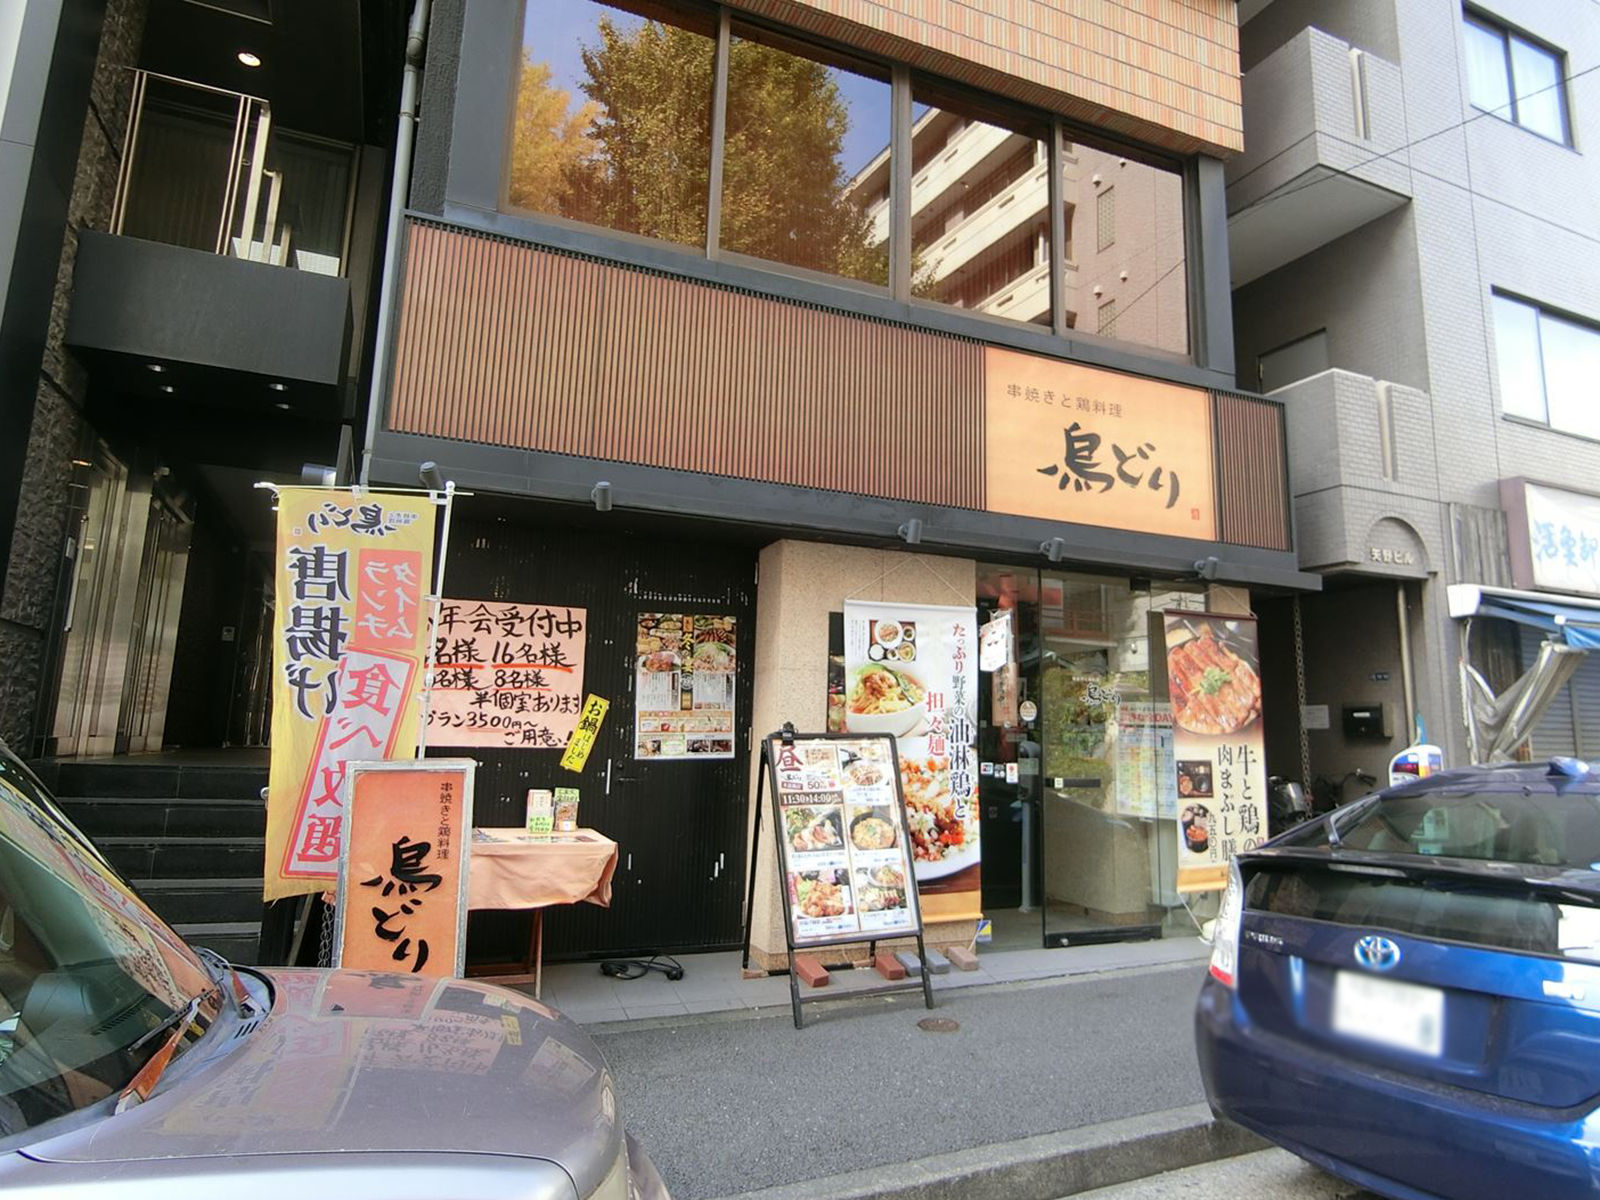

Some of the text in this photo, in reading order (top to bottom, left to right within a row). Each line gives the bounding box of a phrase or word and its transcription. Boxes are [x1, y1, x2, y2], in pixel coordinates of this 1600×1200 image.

[1007, 383, 1124, 418] 串焼きと鶏料理
[1037, 422, 1180, 509] 鳥どり
[427, 603, 583, 639] 年会受付中
[492, 641, 577, 667] 16名様
[433, 667, 550, 691] 名様 8名様
[470, 691, 581, 715] 半個室あります
[775, 746, 804, 772] 昼
[360, 836, 443, 973] 鳥どり
